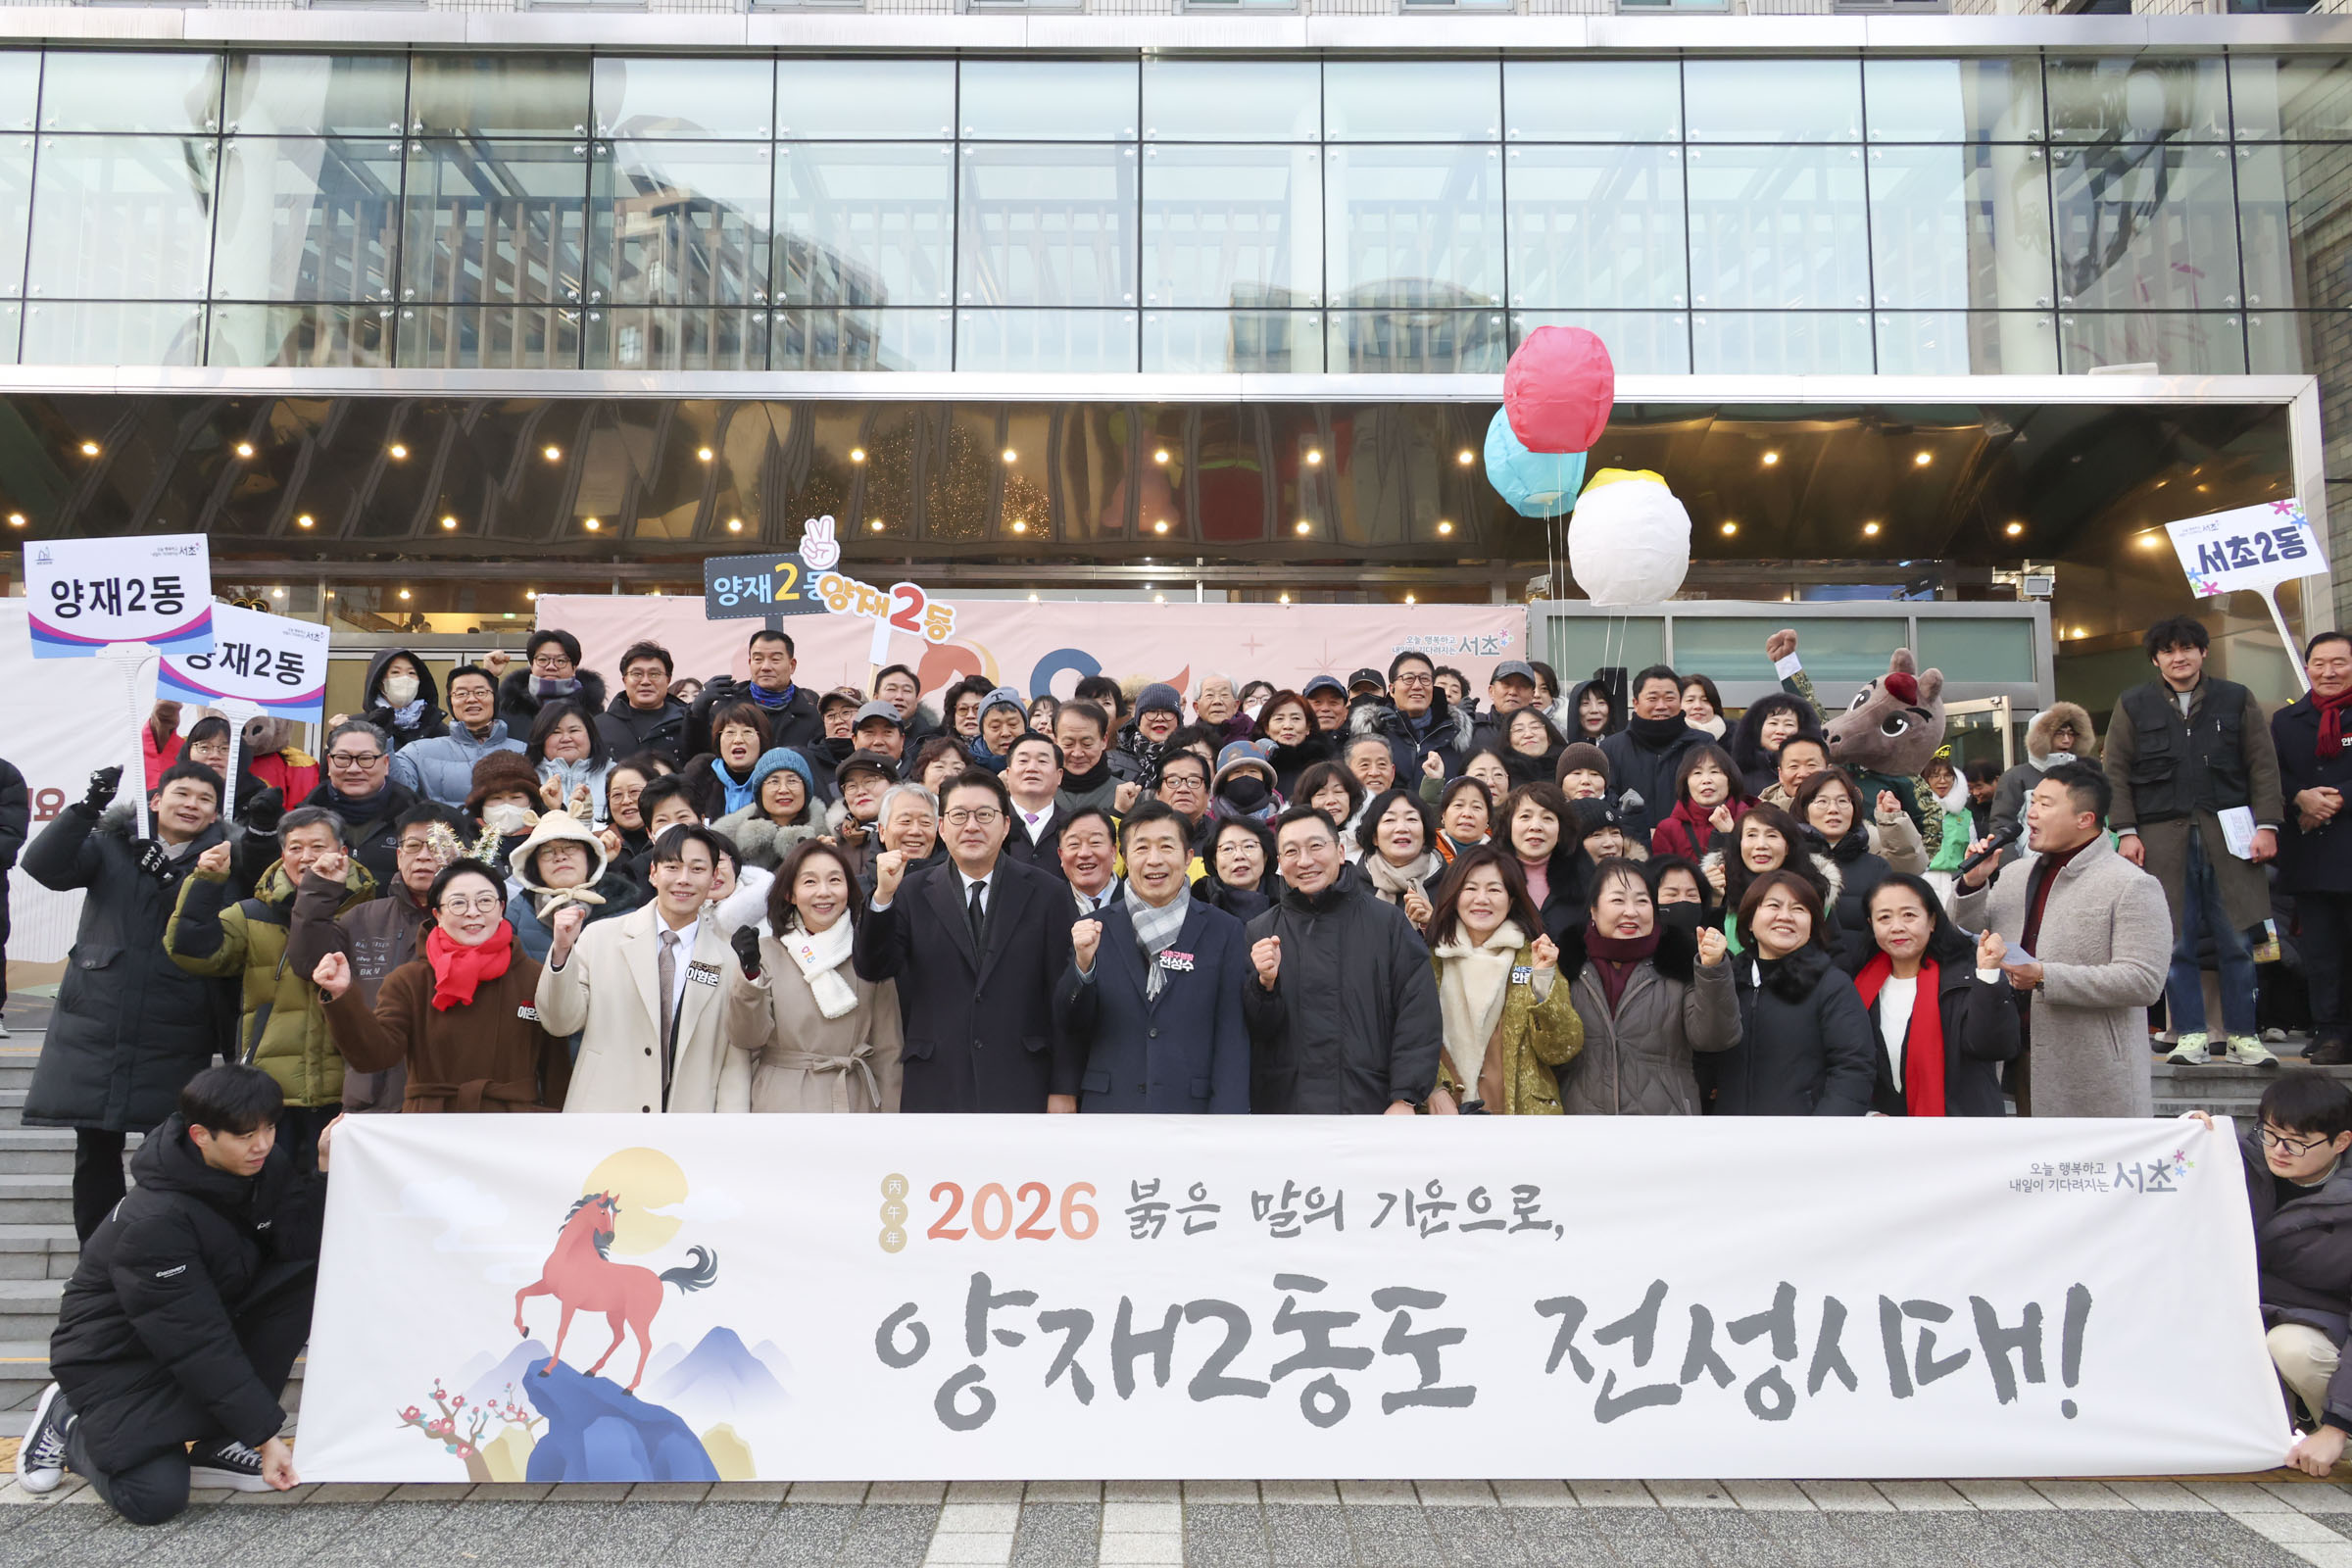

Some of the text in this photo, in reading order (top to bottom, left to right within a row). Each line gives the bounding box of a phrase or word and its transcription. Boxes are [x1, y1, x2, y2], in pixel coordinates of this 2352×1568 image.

[179, 545, 196, 556] 서초
[2197, 525, 2308, 574] 서초2동
[51, 576, 185, 618] 양재2동
[819, 575, 954, 640] 양재2동
[1425, 636, 1456, 645] 행복하고
[1459, 635, 1500, 656] 서초
[27, 788, 66, 821] 요
[686, 967, 719, 987] 이형준
[1159, 956, 1195, 972] 전성수
[2009, 1178, 2110, 1193] 내일이 기다려지는
[2030, 1162, 2106, 1176] 오늘 행복하고
[2114, 1158, 2178, 1194] 서초
[885, 1179, 903, 1247] 丙午年
[927, 1178, 1564, 1242] 2026 붉은 말의 기운으로,
[875, 1272, 2093, 1431] 양재2동도 전성시대!
